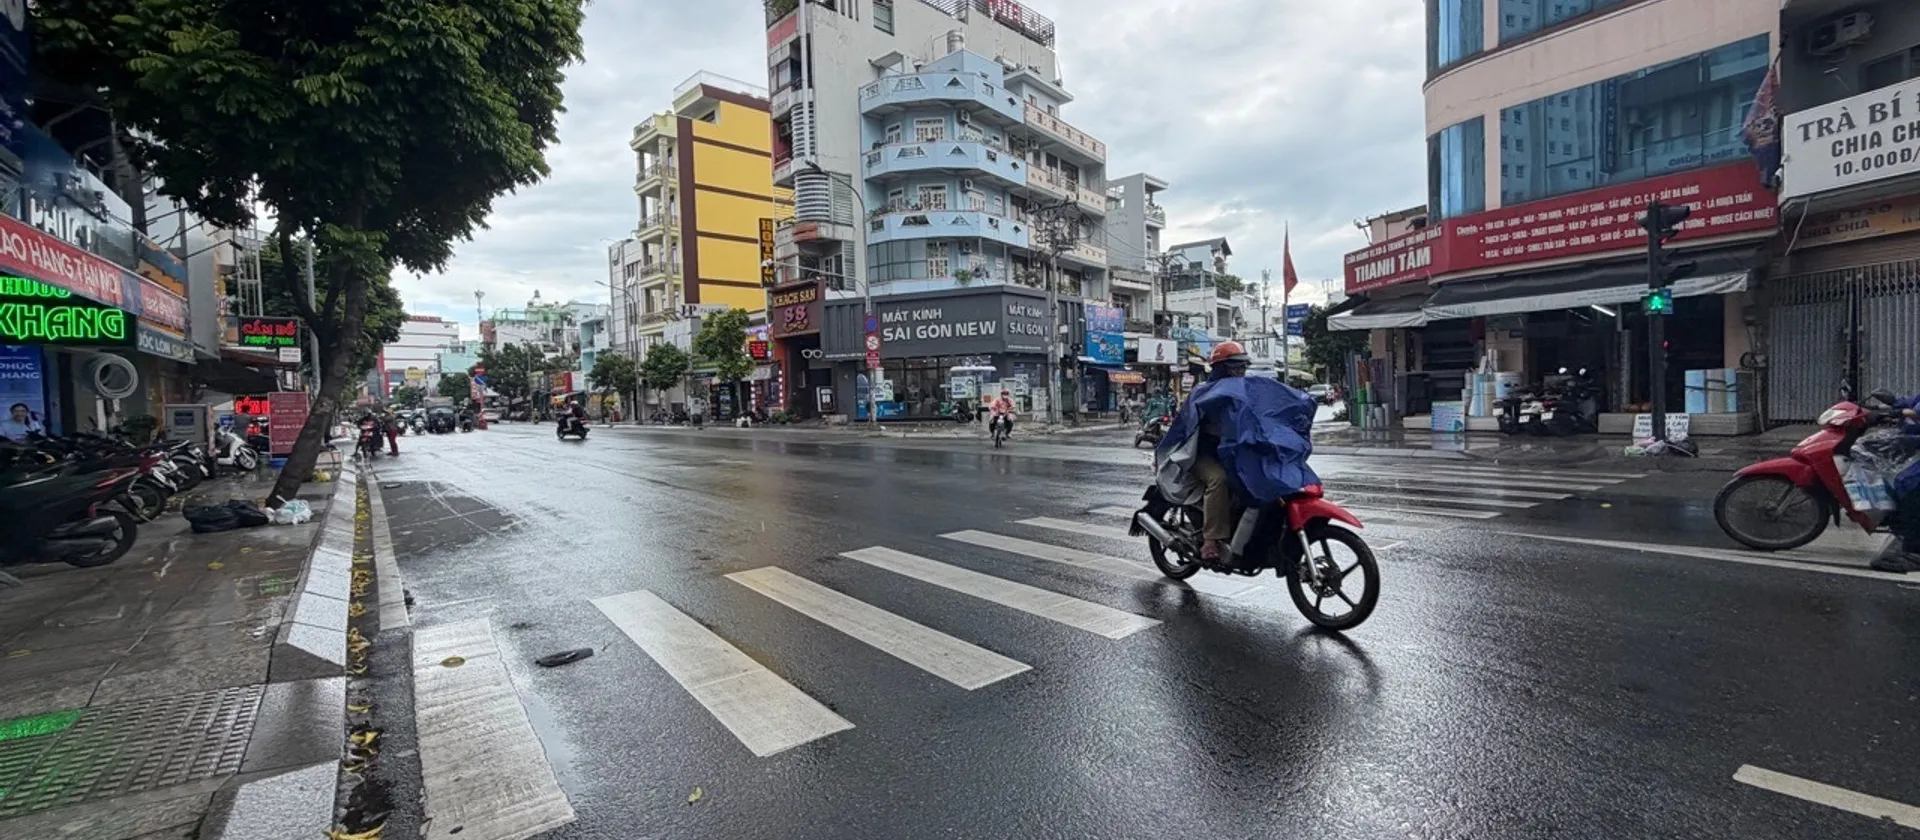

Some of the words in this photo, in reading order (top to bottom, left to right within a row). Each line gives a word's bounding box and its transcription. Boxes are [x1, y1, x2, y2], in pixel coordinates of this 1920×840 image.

[1798, 106, 1856, 142] TRÀ
[1868, 91, 1902, 124] BÍ
[1831, 131, 1882, 158] CHIA
[28, 234, 74, 278] HÀNG
[1355, 257, 1395, 283] THANH
[1398, 246, 1432, 272] TÂM
[774, 292, 798, 307] KHÁCH
[784, 305, 806, 322] 88
[913, 304, 942, 321] KÍNH
[883, 323, 910, 342] SÀI
[916, 321, 951, 339] GÒN
[955, 321, 996, 338] NEW
[1009, 320, 1024, 335] SÀI
[1026, 320, 1044, 336] GÒN
